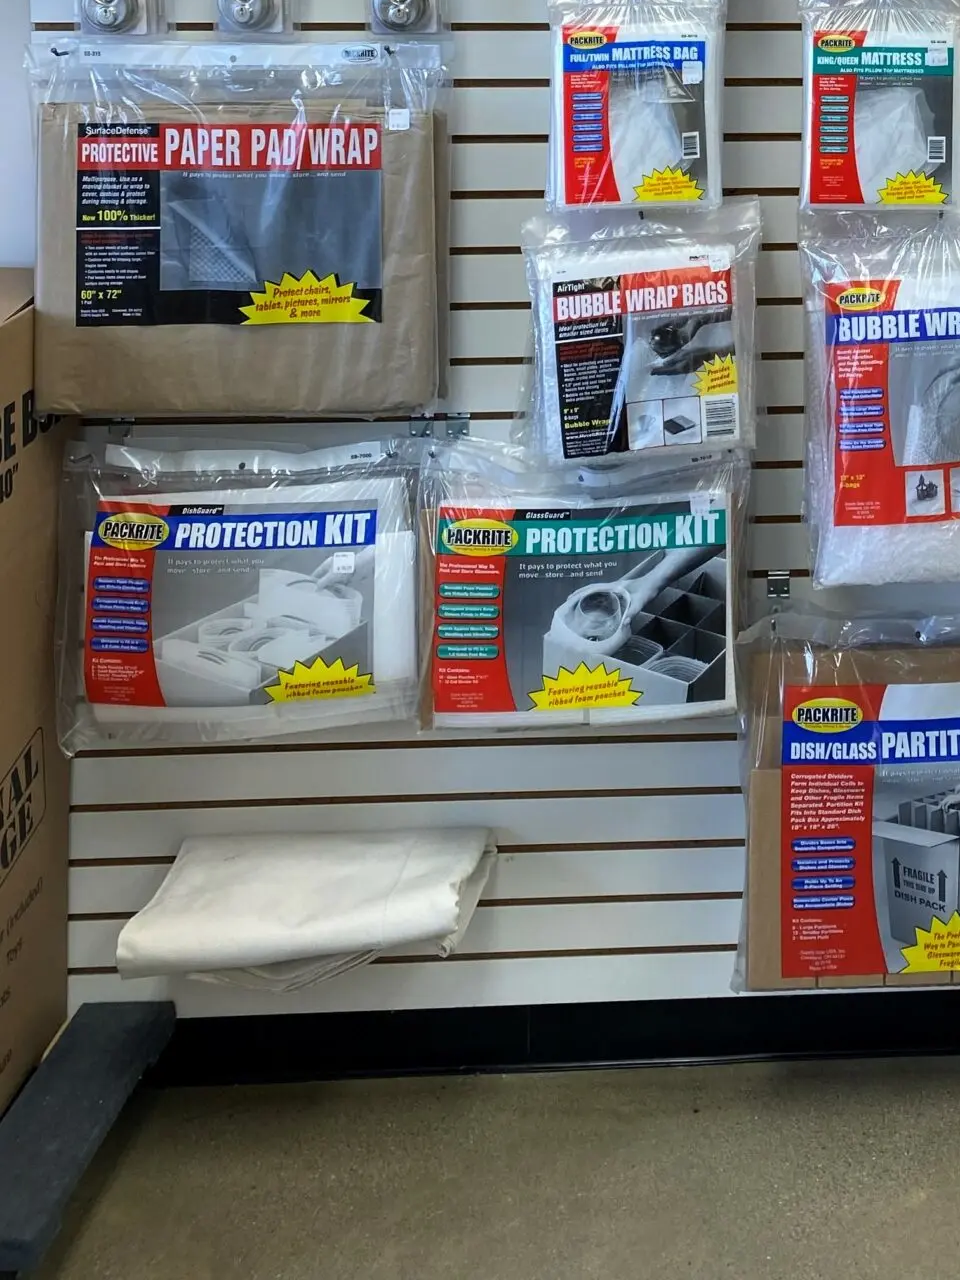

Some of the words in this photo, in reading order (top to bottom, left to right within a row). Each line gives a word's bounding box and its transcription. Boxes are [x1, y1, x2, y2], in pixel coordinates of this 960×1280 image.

[570, 36, 604, 45] PACKRITE
[820, 39, 853, 47] PACKRITE
[570, 52, 610, 63] FULL/TWIN
[612, 46, 671, 62] MATTRESS
[674, 46, 698, 60] BAG
[861, 51, 922, 66] MATTRESS
[81, 142, 158, 163] PROTECTIVE
[166, 128, 241, 167] PAPER
[97, 209, 128, 221] 100%
[273, 287, 304, 299] Protect
[321, 295, 351, 305] mirrors
[557, 291, 622, 321] BUBBLE
[625, 285, 678, 312] WRAP
[682, 280, 728, 307] BAGS
[289, 307, 297, 318] &
[301, 309, 321, 318] more
[838, 314, 921, 341] BUBBLE
[104, 523, 164, 540] PACKRITE
[175, 520, 318, 549] PROTECTION
[323, 513, 371, 544] KIT
[447, 527, 511, 547] PACKRITE
[526, 522, 668, 554] PROTECTION
[675, 513, 720, 546] KIT
[527, 563, 544, 572] pays
[556, 563, 582, 572] protect
[604, 561, 618, 570] you
[547, 683, 585, 697] Featuring
[586, 681, 619, 693] reusable
[548, 696, 573, 707] ribbed
[574, 694, 593, 704] foam
[594, 690, 626, 704] pouches
[797, 707, 859, 723] PACKRITE
[790, 742, 877, 760] DISH/GLASS
[903, 866, 935, 884] FRAGILE
[894, 889, 917, 905] DISH
[918, 898, 946, 913] PACK
